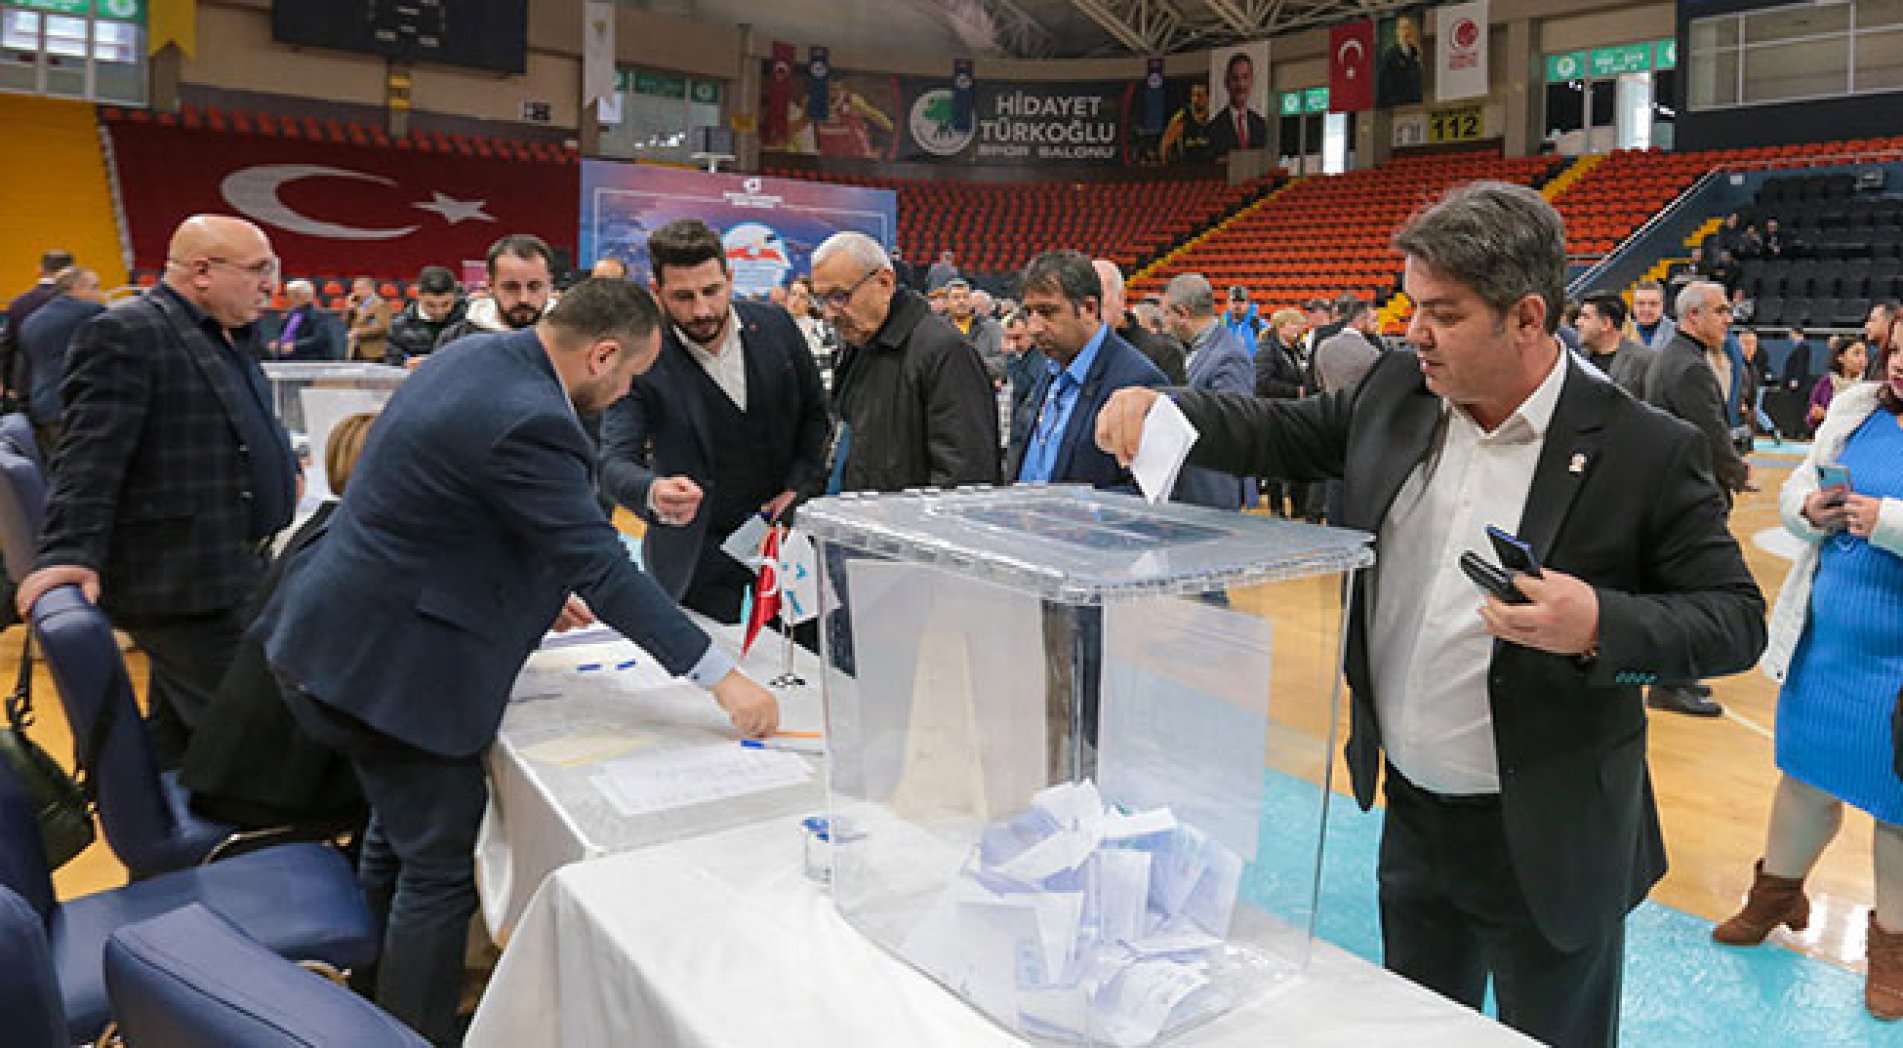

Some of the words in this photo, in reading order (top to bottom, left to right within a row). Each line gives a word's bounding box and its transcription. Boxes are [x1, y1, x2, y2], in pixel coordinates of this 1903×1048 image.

[996, 91, 1101, 115] HİDAYET
[980, 117, 1115, 143] TÜRKOĞLU
[1431, 116, 1477, 138] 112
